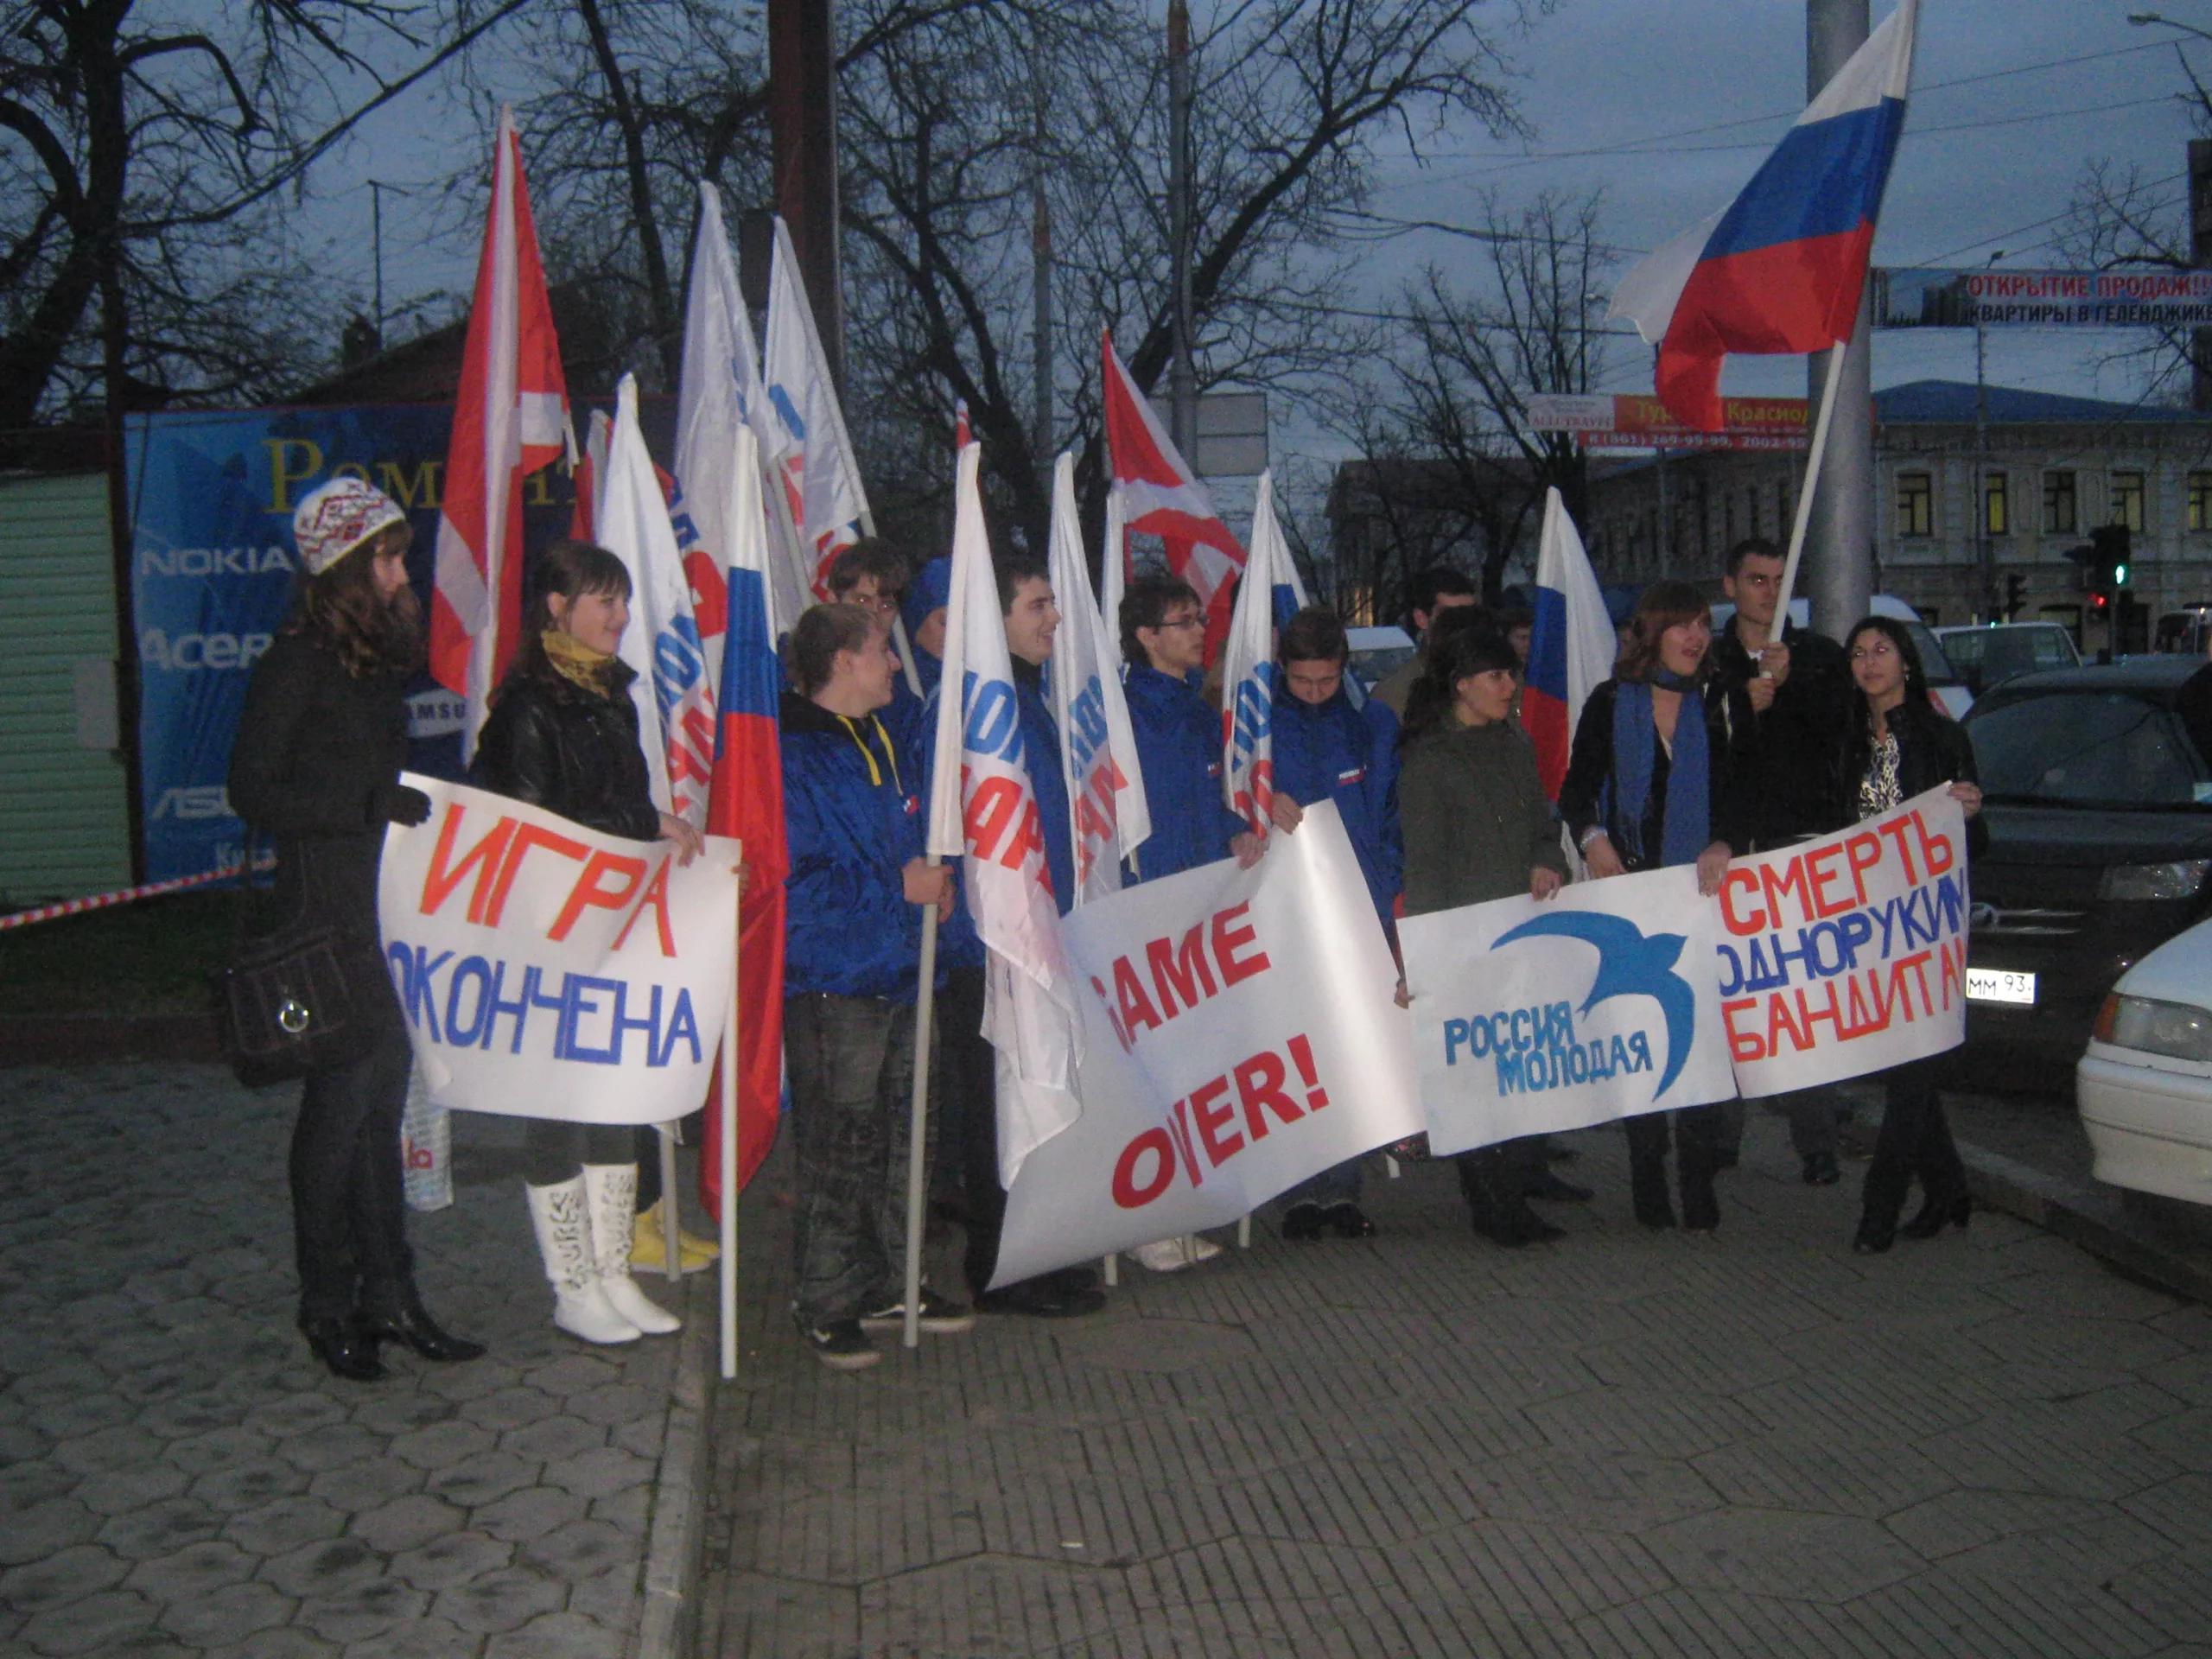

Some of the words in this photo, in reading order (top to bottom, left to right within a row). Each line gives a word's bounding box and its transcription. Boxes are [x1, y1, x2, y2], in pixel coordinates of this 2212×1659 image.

[1968, 275, 2090, 297] ОТКРЫТИЕ
[1970, 304, 2072, 323] КВАРТИРЫ
[2077, 304, 2090, 323] В
[139, 545, 296, 576] NOKIA
[419, 802, 677, 958] ИГРА
[1719, 809, 1954, 936] СМЕРТЬ
[1443, 1001, 1576, 1066] РОССИЯ
[1495, 1029, 1654, 1097] МОЛОДАЯ
[1112, 1033, 1331, 1209] OVER!
